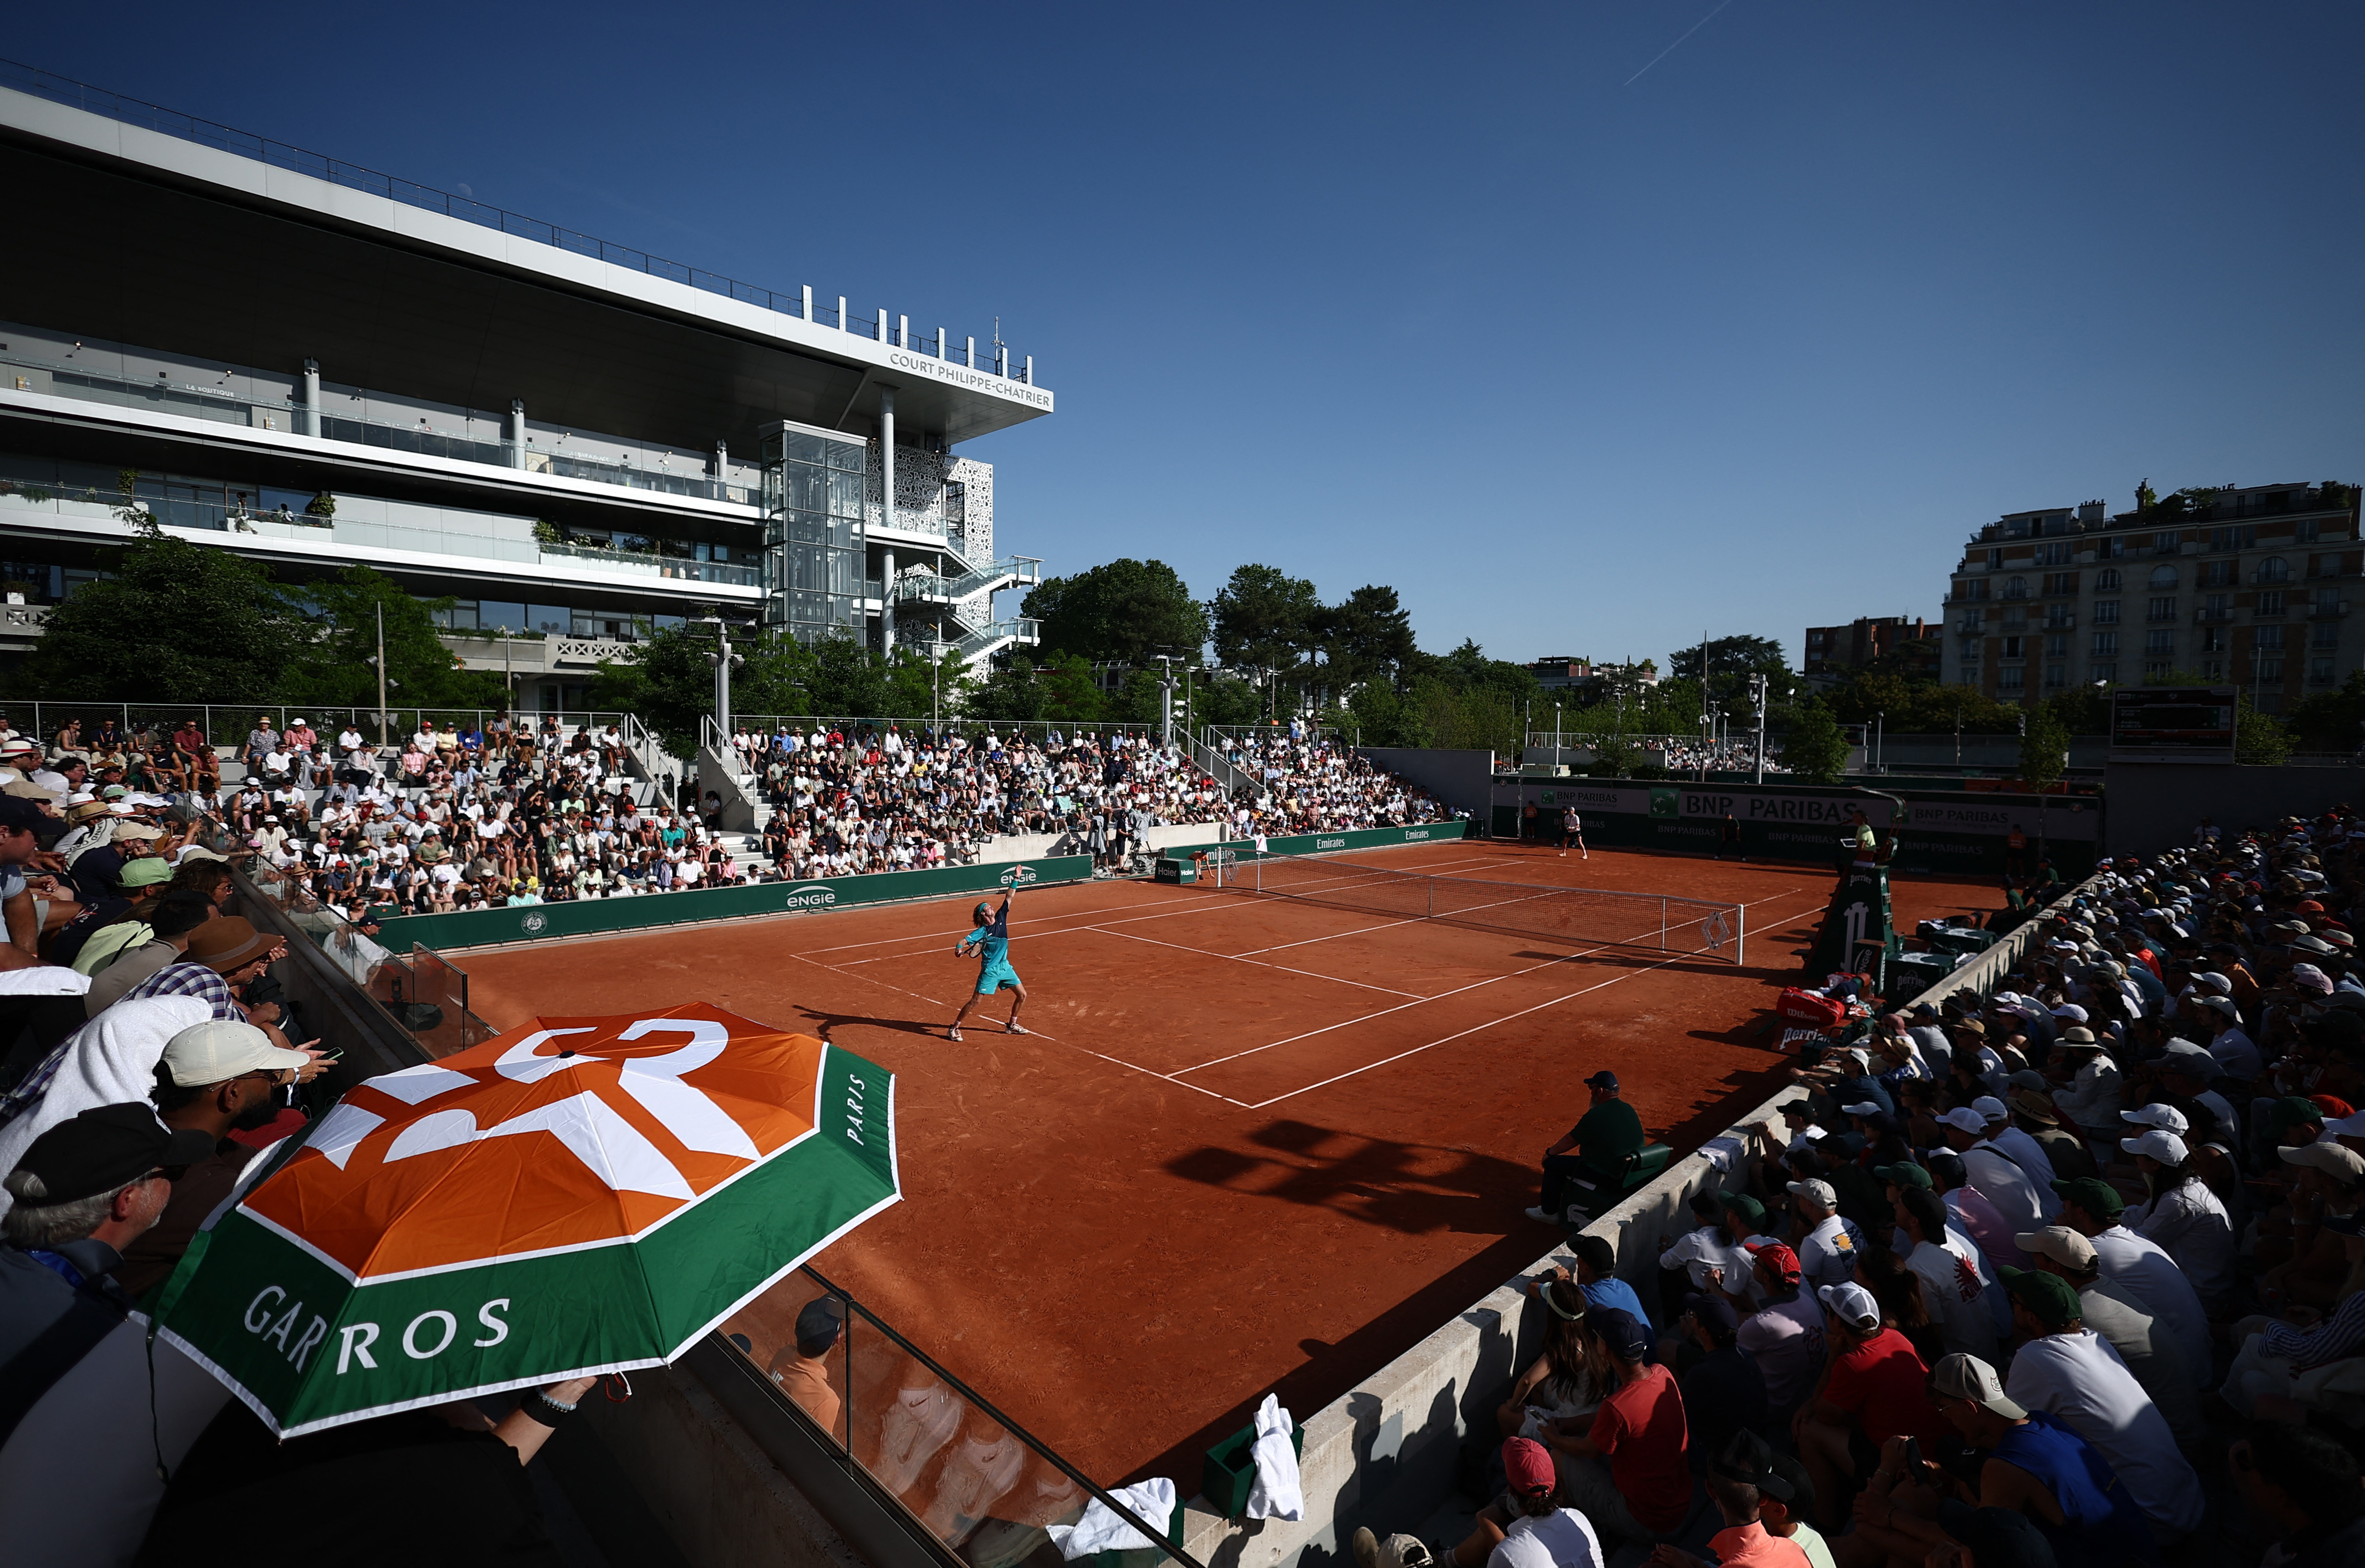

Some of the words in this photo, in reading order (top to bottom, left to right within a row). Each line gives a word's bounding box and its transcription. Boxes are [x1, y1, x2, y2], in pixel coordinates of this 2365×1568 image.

[890, 353, 935, 374] COURT
[938, 366, 1050, 406] PHILIPPE-CHATRIER
[1557, 792, 1575, 800] BNP
[1578, 793, 1617, 803] PARIBAS
[1687, 796, 1734, 815] BNP
[1750, 799, 1857, 822] PARIBAS
[1915, 809, 1944, 820] BNP
[1947, 810, 2008, 824] PARIBAS
[1581, 820, 1605, 828] RIBAS
[1405, 830, 1429, 840] Emirates
[1679, 827, 1716, 837] PARIBAS
[1768, 832, 1789, 841] BNP
[1791, 834, 1836, 844] PARIBAS
[1317, 838, 1345, 849] Emirates
[1904, 841, 1929, 850] BNP
[1931, 843, 1983, 855] PARIBAS
[1158, 867, 1177, 877] Haier
[1787, 1008, 1820, 1022] Wilson
[847, 1074, 865, 1146] PARIS
